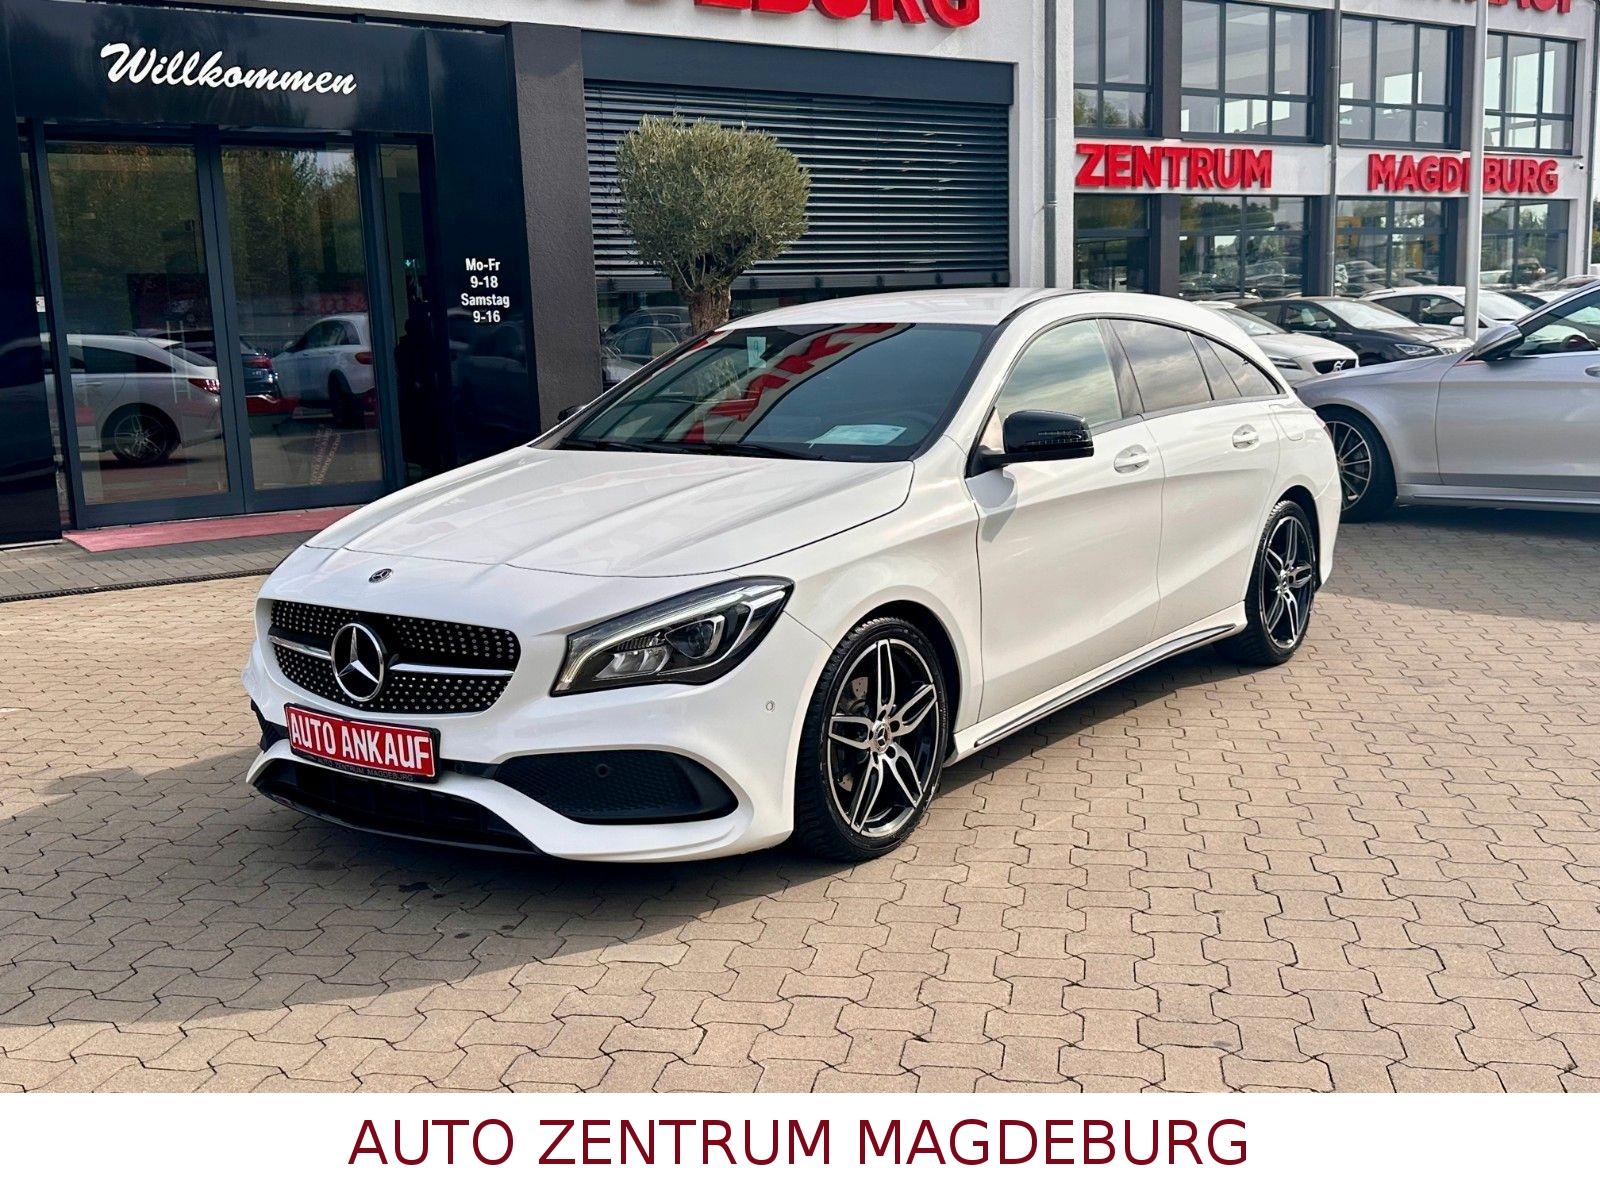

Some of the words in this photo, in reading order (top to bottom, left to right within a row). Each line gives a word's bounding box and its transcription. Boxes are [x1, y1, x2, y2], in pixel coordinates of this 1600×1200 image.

[100, 43, 357, 95] Willkommen
[1076, 143, 1272, 188] ZENTRUM
[465, 258, 501, 271] Mo-Fr
[470, 276, 498, 288] 9-18
[460, 293, 510, 308] Samstag
[472, 310, 501, 323] 9-16
[290, 712, 336, 755] AUTO
[342, 725, 430, 770] ANKAUF
